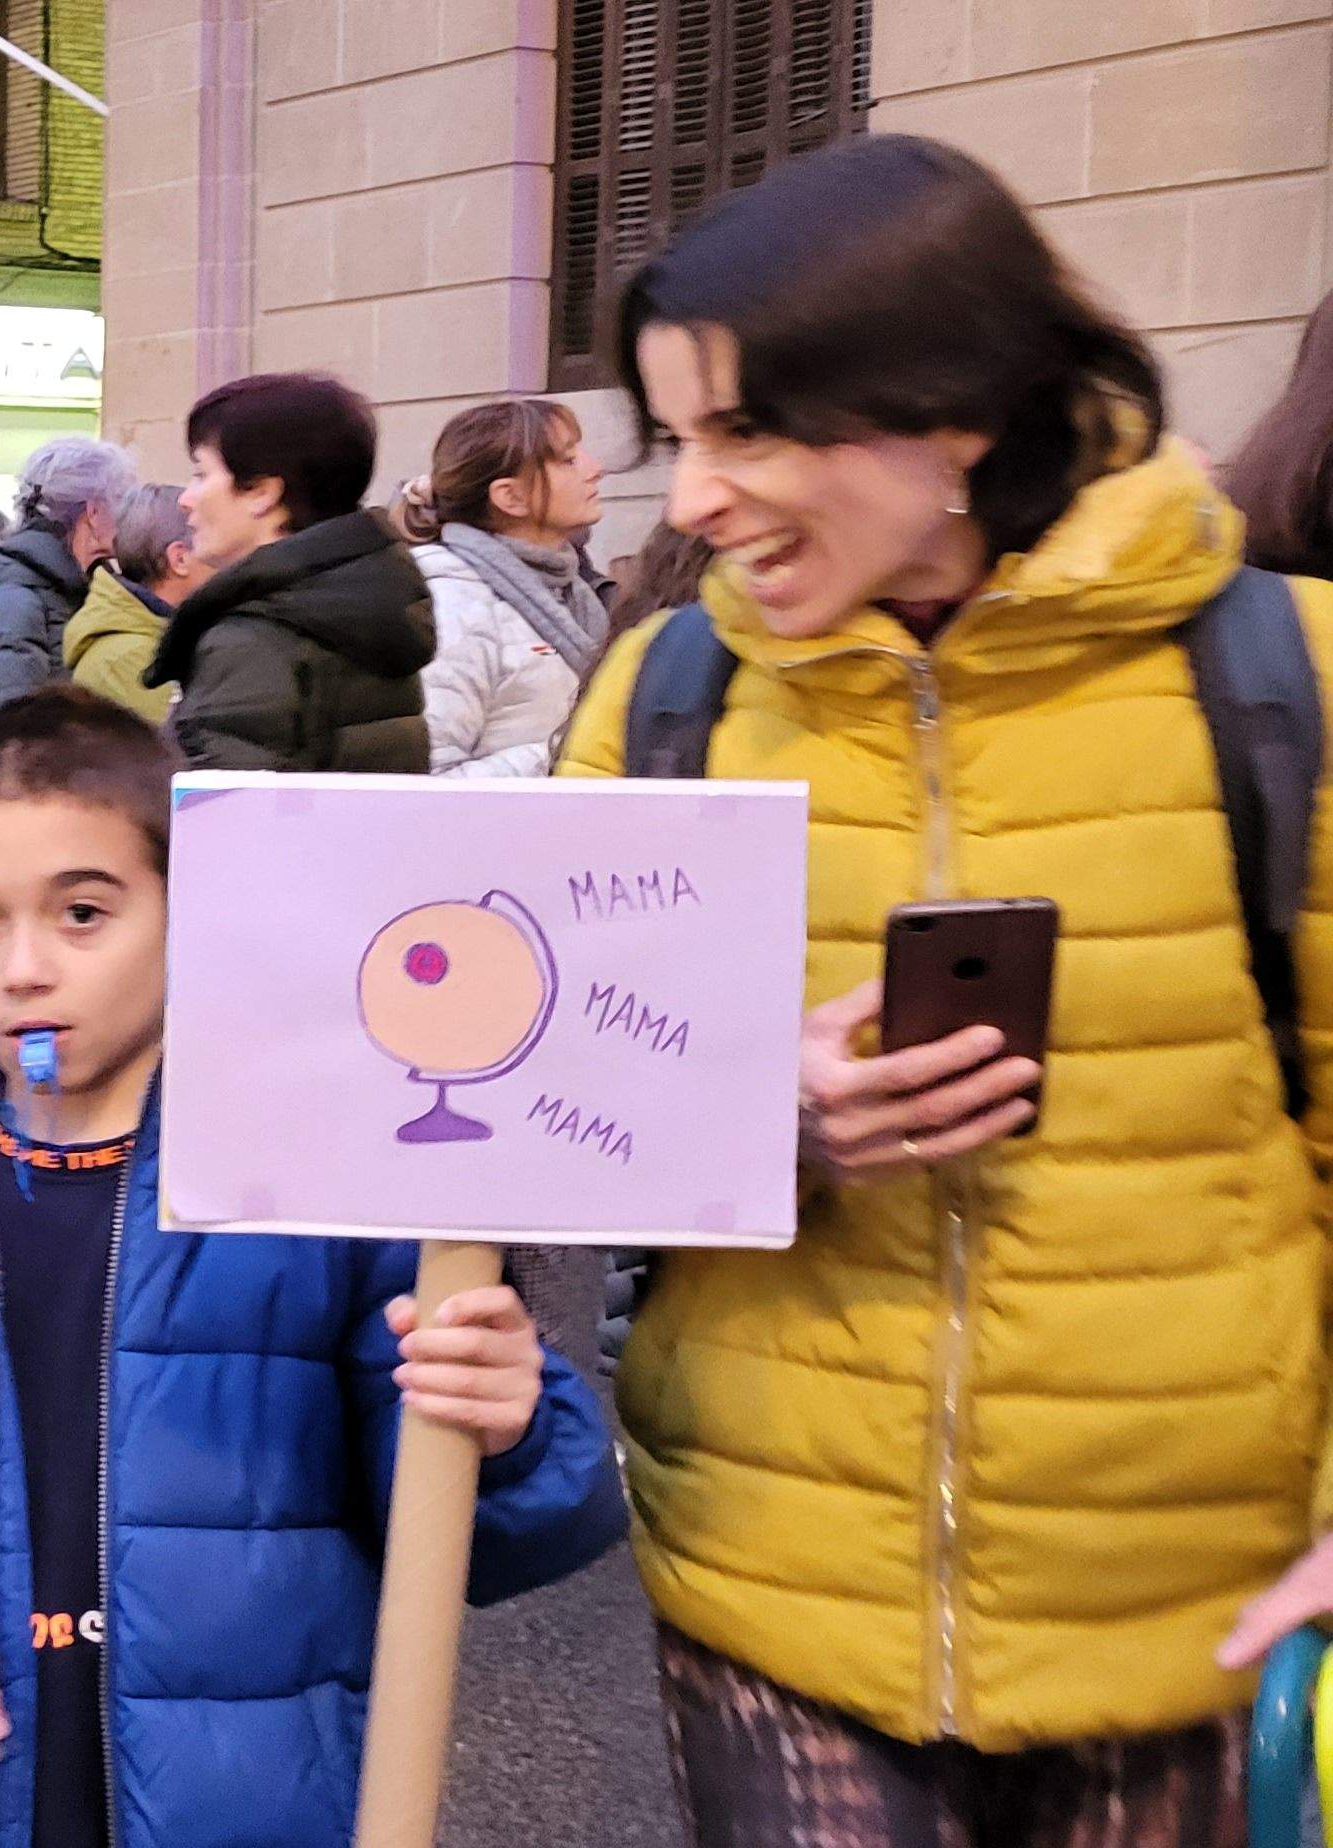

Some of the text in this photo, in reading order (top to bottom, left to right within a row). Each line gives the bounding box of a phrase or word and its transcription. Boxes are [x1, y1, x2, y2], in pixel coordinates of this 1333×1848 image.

[568, 867, 701, 922] MAMA
[584, 981, 689, 1057] MAMA
[526, 1093, 633, 1166] MAMA
